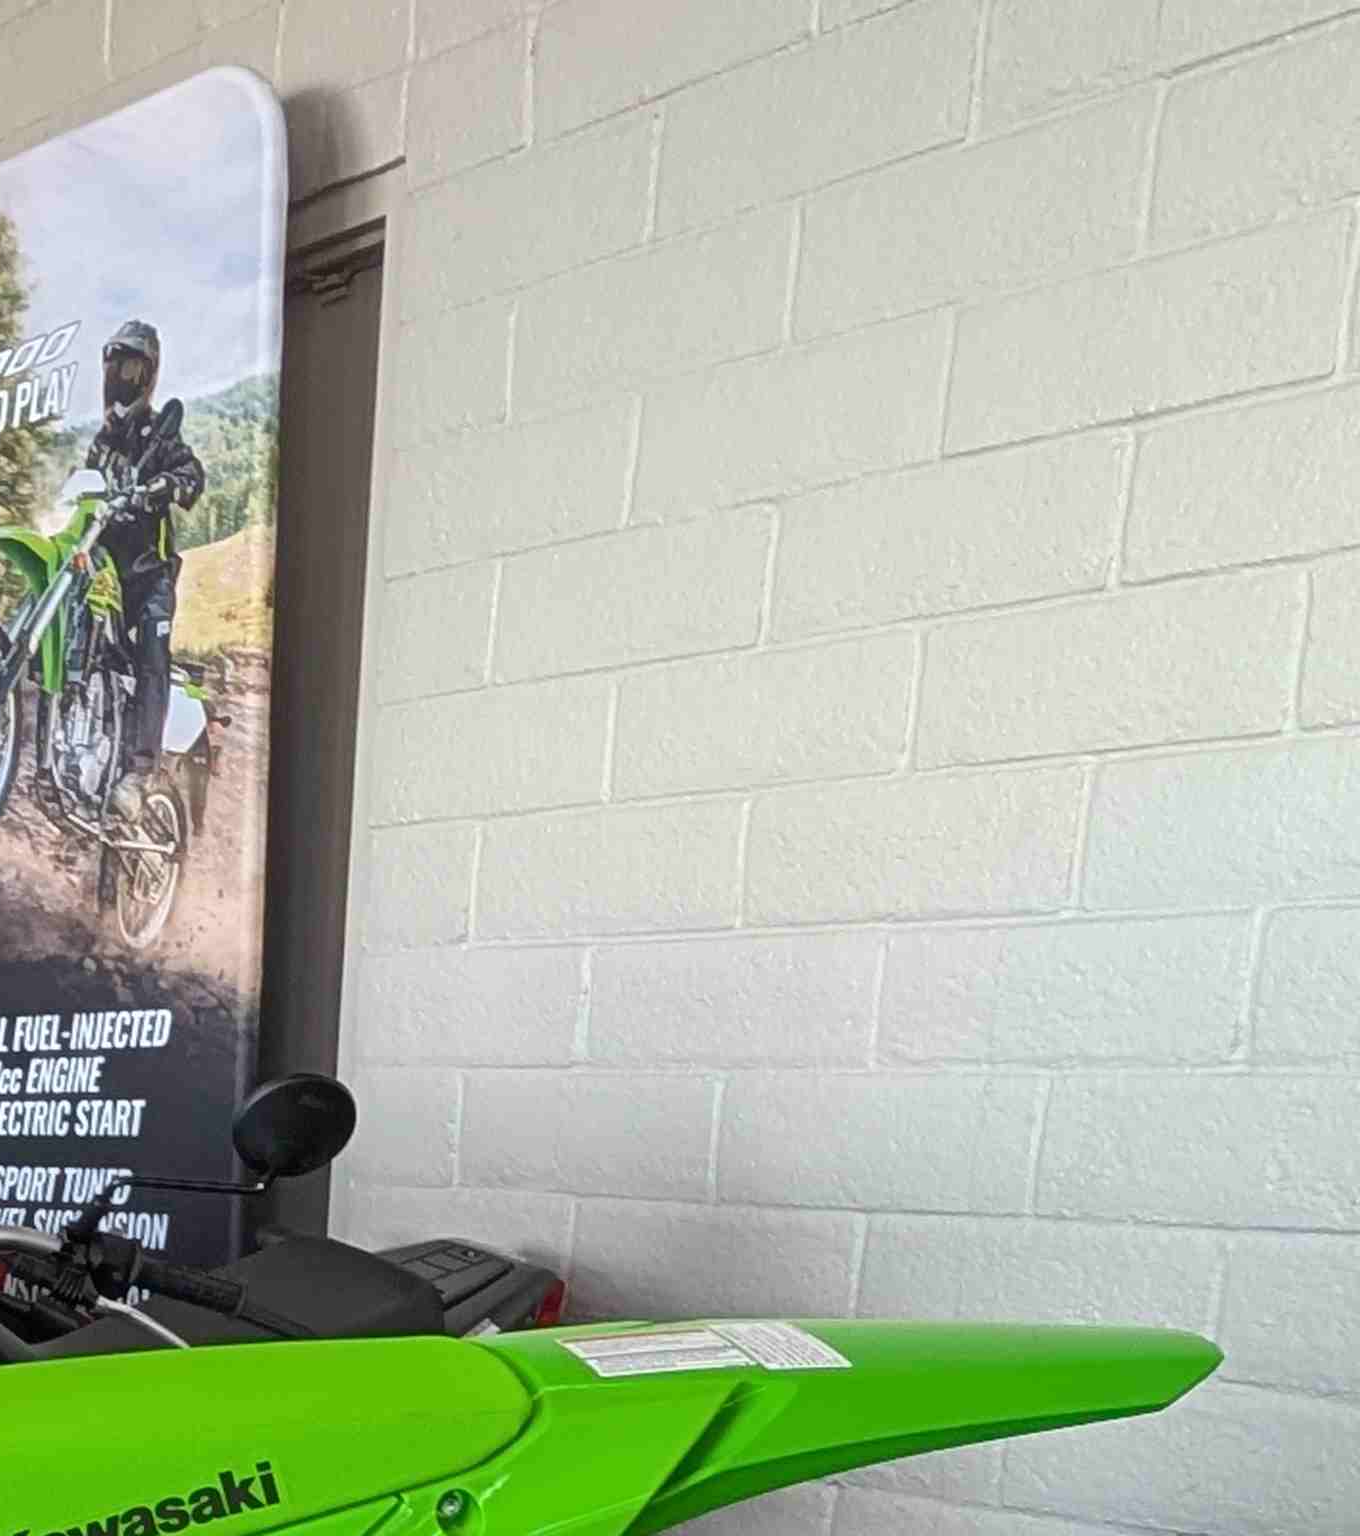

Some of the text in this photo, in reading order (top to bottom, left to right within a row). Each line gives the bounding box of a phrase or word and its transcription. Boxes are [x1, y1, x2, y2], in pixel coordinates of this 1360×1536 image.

[12, 362, 79, 428] PLAY
[11, 1009, 173, 1052] FUEL-INJECTED
[26, 1056, 105, 1094] ENGINE
[73, 1099, 146, 1137] START
